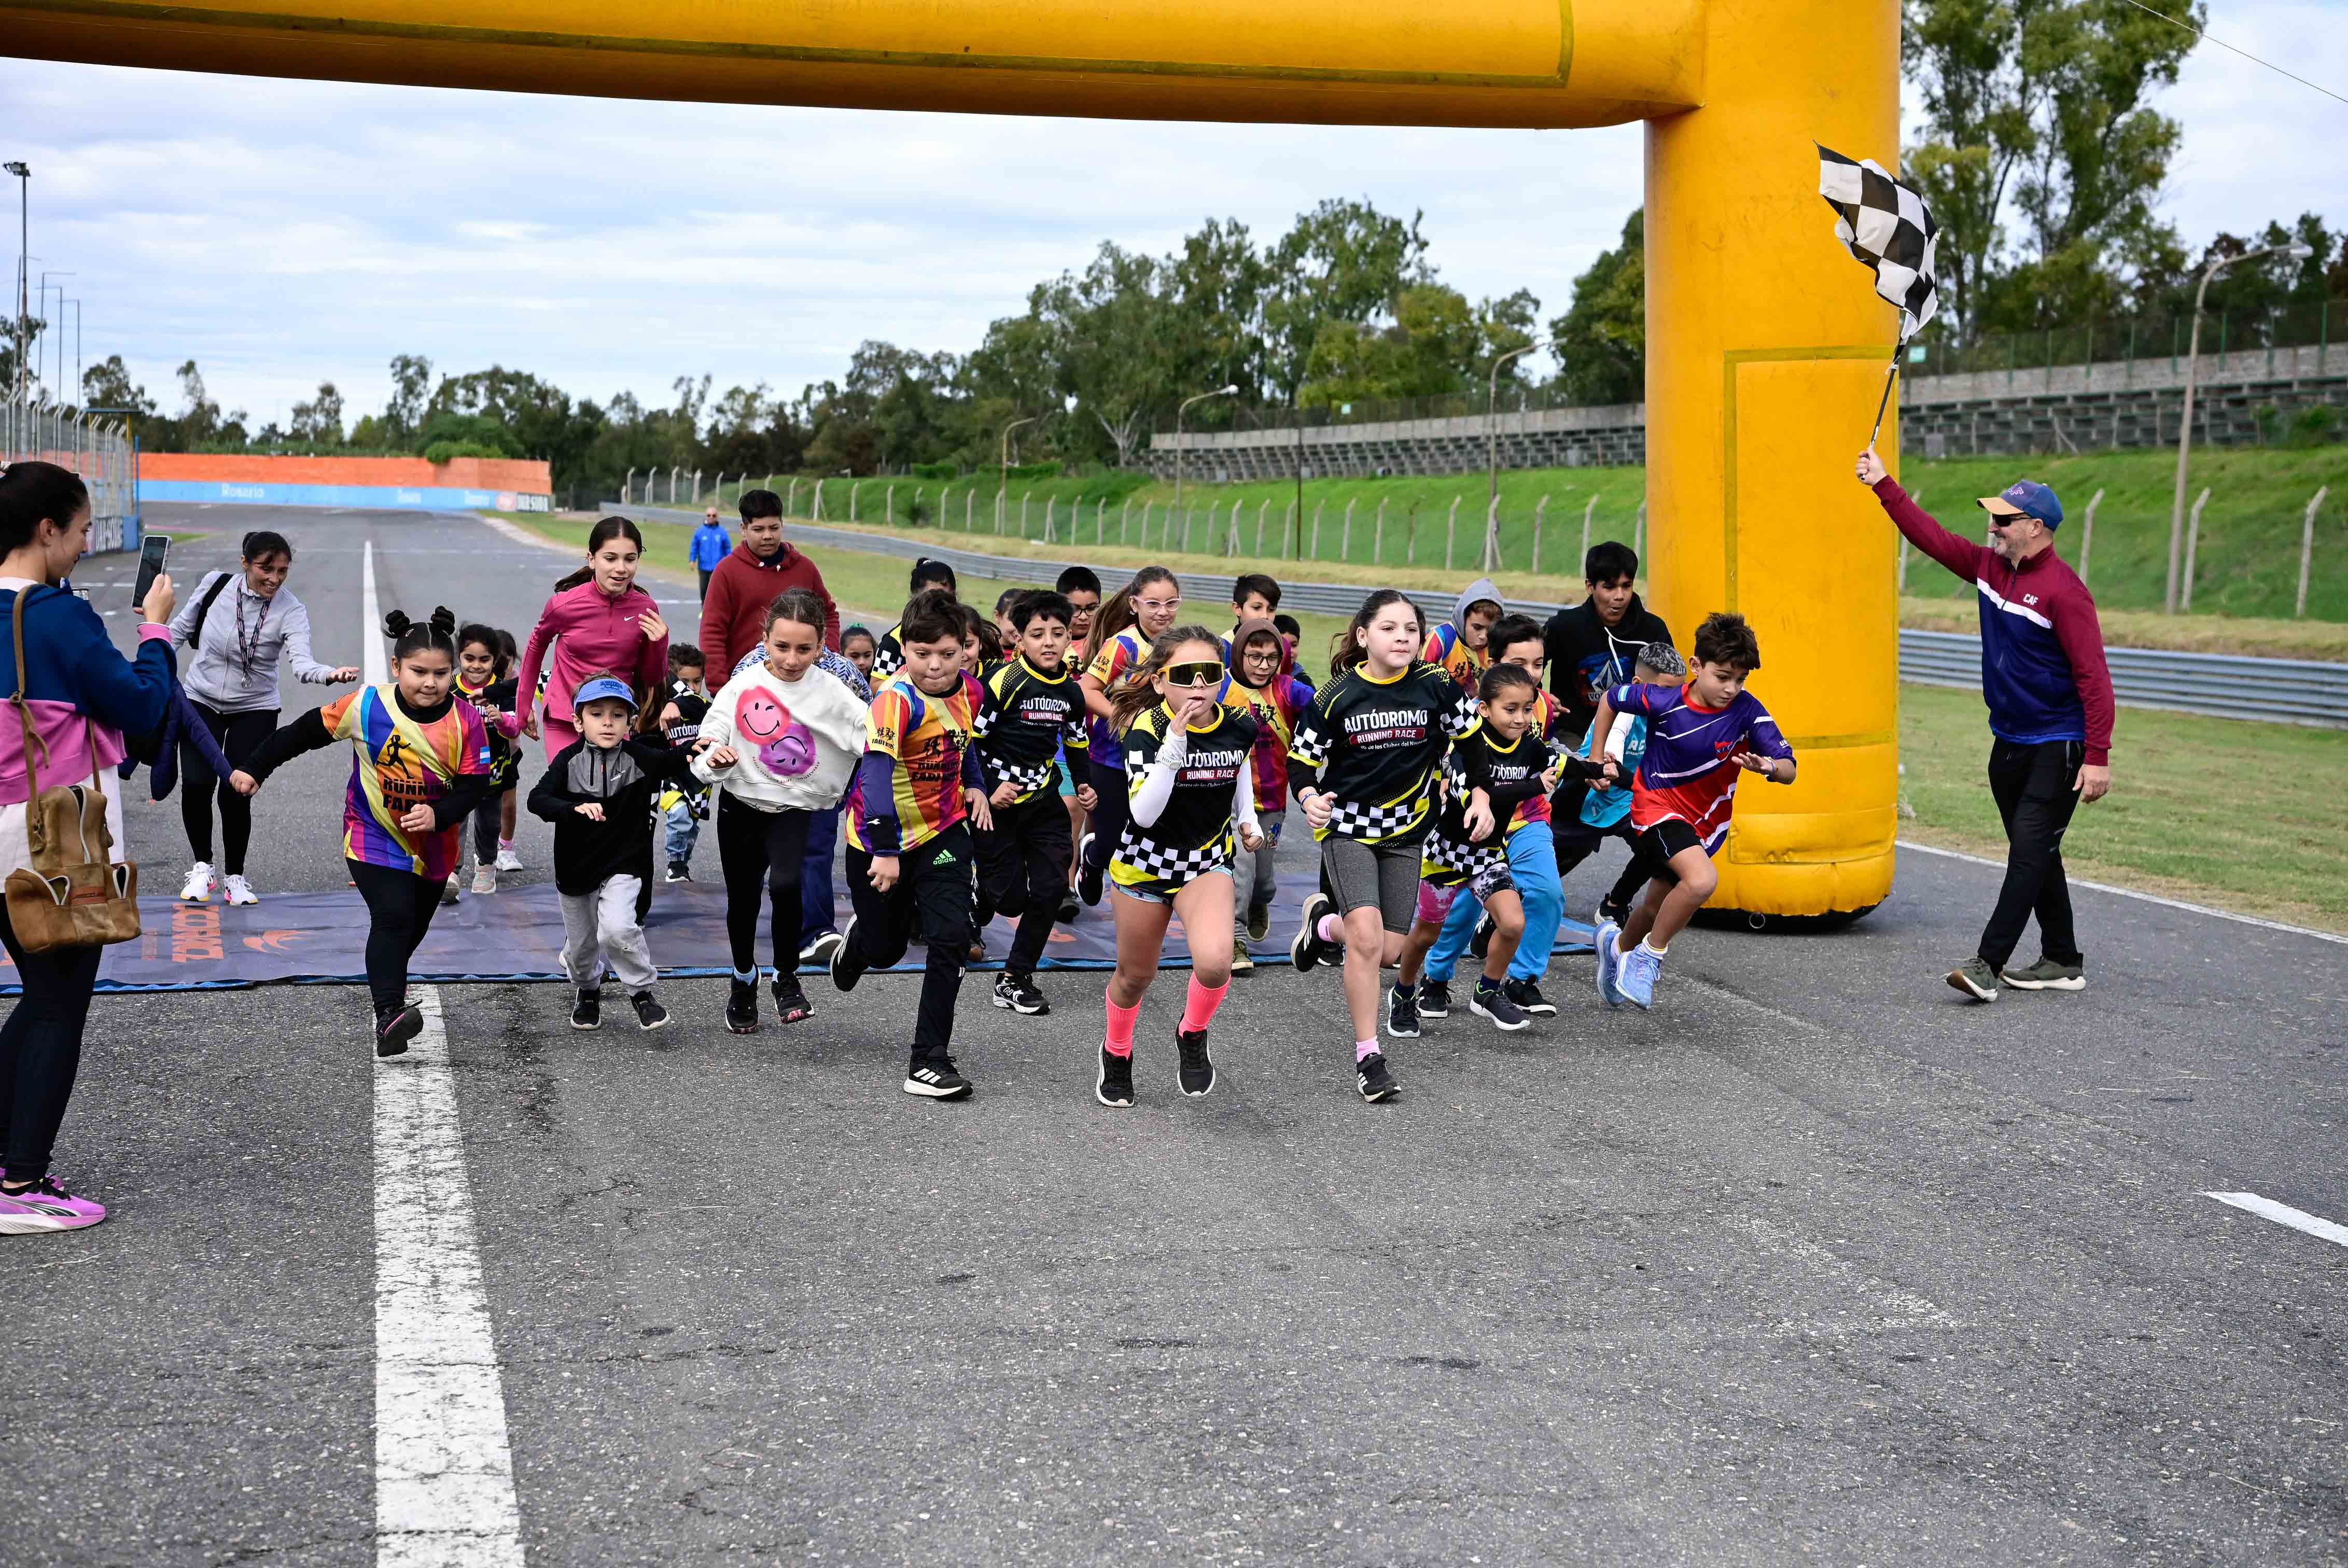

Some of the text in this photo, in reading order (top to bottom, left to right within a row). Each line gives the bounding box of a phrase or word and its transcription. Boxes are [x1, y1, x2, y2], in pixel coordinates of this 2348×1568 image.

[221, 483, 265, 498] Rosario
[2023, 594, 2038, 606] CAF
[1019, 695, 1071, 713] AUTÓDROM
[1345, 709, 1428, 733] AUTÓDROMO
[1357, 730, 1416, 744] RUNNING RACE
[1217, 770, 1235, 778] RACE
